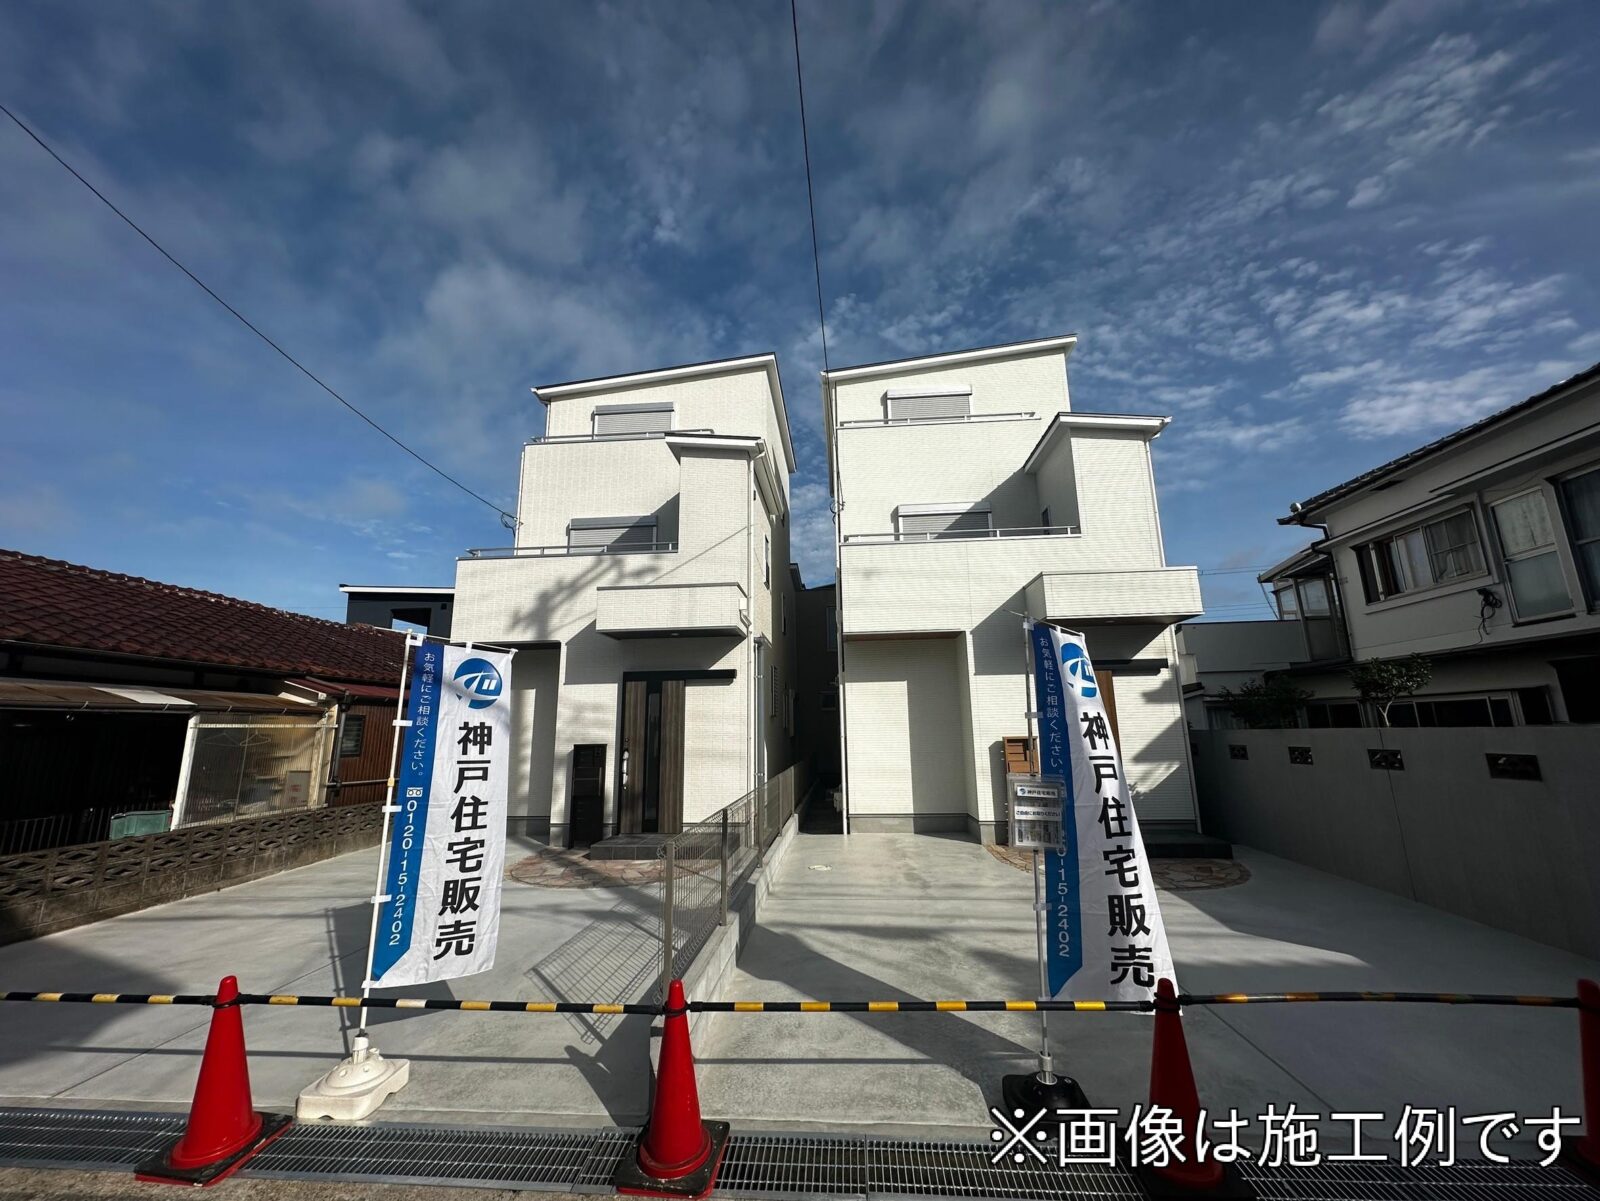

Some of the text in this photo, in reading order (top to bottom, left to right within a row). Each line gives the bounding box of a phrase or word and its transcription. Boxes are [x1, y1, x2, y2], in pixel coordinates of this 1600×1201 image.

[411, 652, 436, 776] お気軽にご相談ください。
[388, 799, 418, 946] 0120-15-2402
[433, 721, 493, 961] 神戸住宅販売
[1079, 711, 1155, 988] 神戸住宅販売
